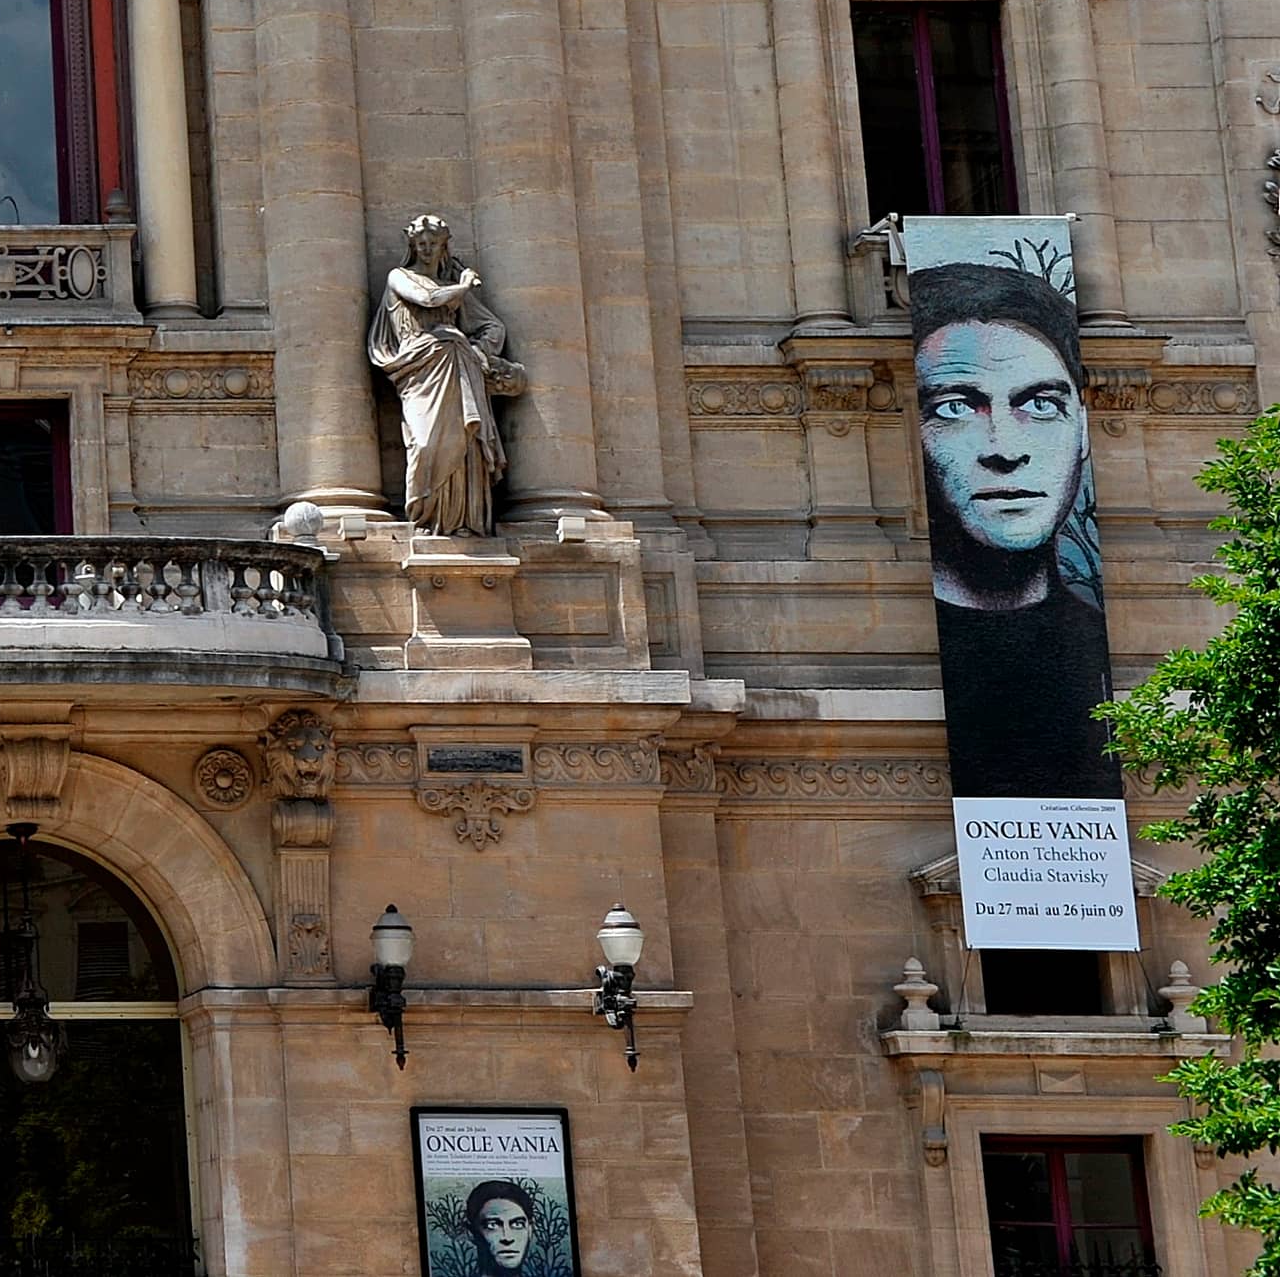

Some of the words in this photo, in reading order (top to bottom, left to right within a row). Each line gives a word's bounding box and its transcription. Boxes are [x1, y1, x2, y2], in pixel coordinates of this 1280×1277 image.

[965, 821, 1042, 840] ONCLE
[1046, 822, 1118, 840] VANIA
[981, 847, 1029, 861] Anton
[1033, 846, 1107, 862] Tchekhov
[984, 867, 1043, 883] Claudia
[1047, 868, 1109, 887] Stavisky
[975, 902, 994, 916] Du
[998, 903, 1012, 916] 27
[1016, 903, 1039, 916] mai
[1045, 906, 1059, 916] au
[1063, 903, 1078, 916] 26
[1080, 904, 1105, 920] juin
[1109, 904, 1124, 917] 09
[426, 1135, 494, 1153] ONCLE
[497, 1135, 560, 1153] VANIA
